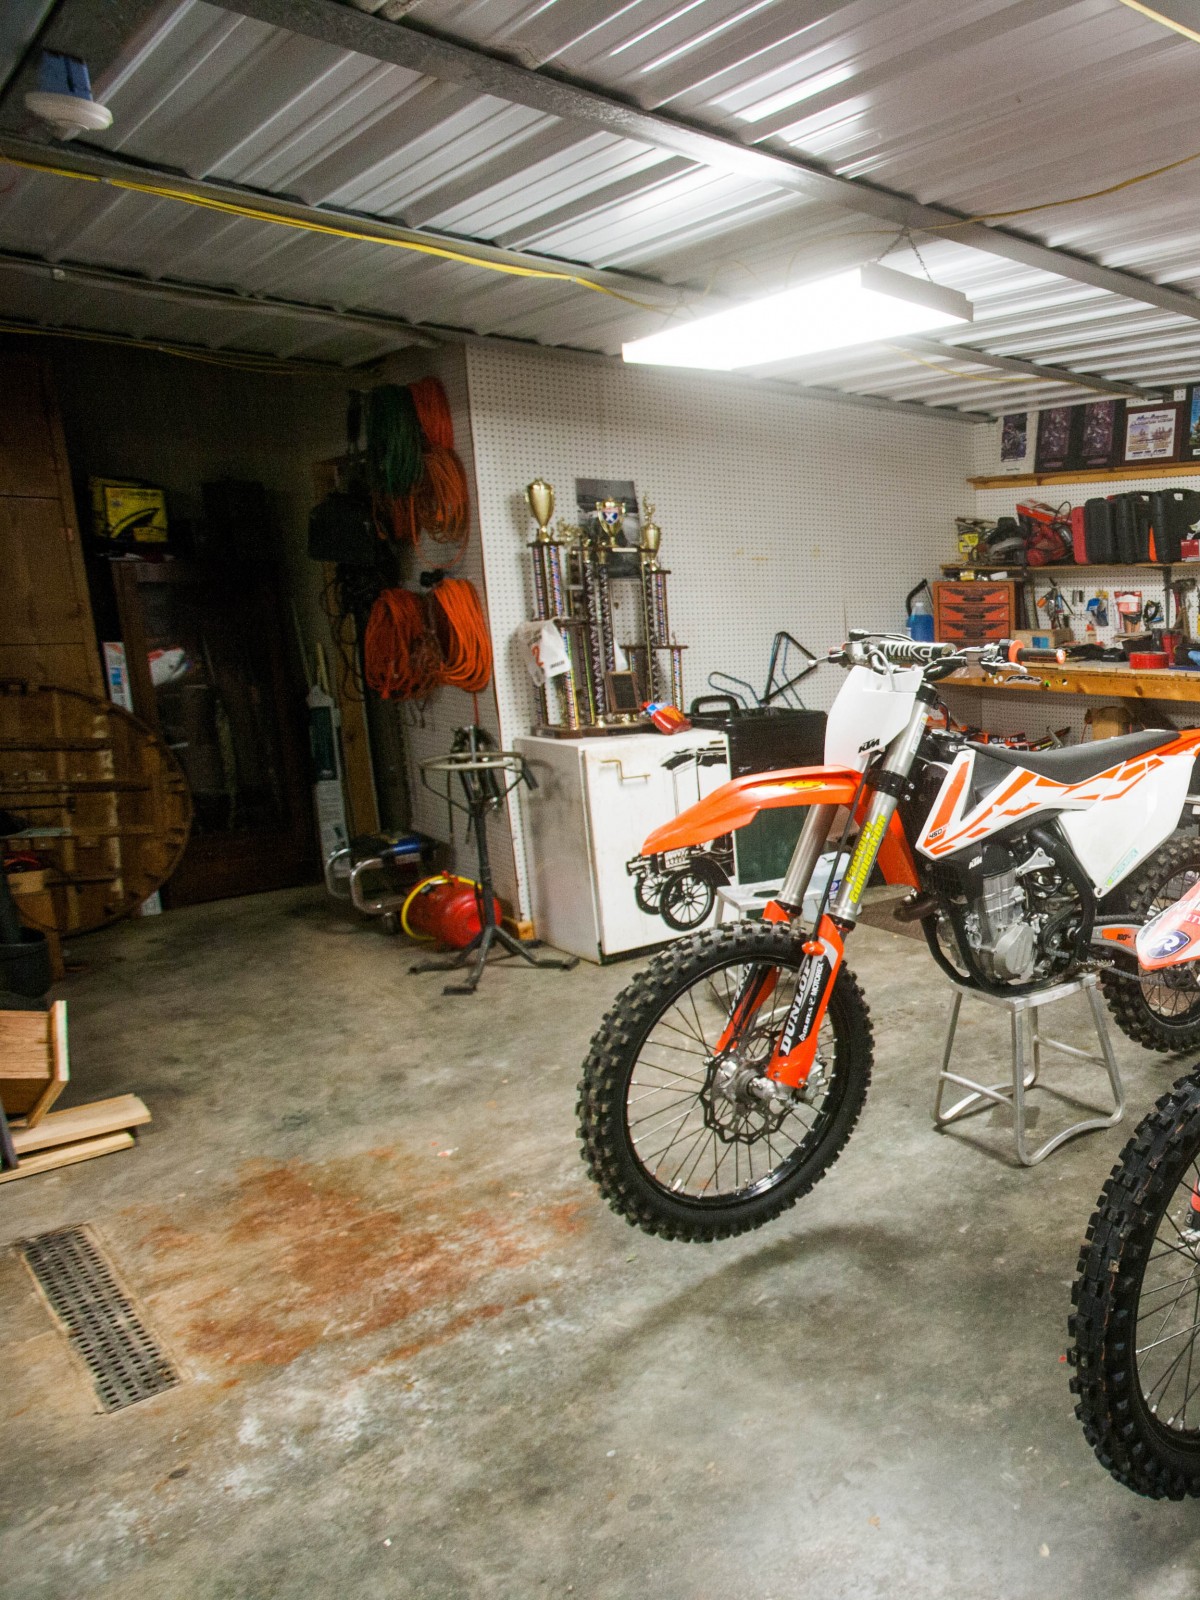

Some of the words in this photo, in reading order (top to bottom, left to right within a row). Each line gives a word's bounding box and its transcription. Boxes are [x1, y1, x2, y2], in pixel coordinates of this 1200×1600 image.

[858, 738, 880, 753] KTM
[928, 826, 945, 840] 450
[968, 856, 983, 870] KTM
[810, 959, 825, 997] MOTOREX
[780, 958, 811, 1056] DUNLOP
